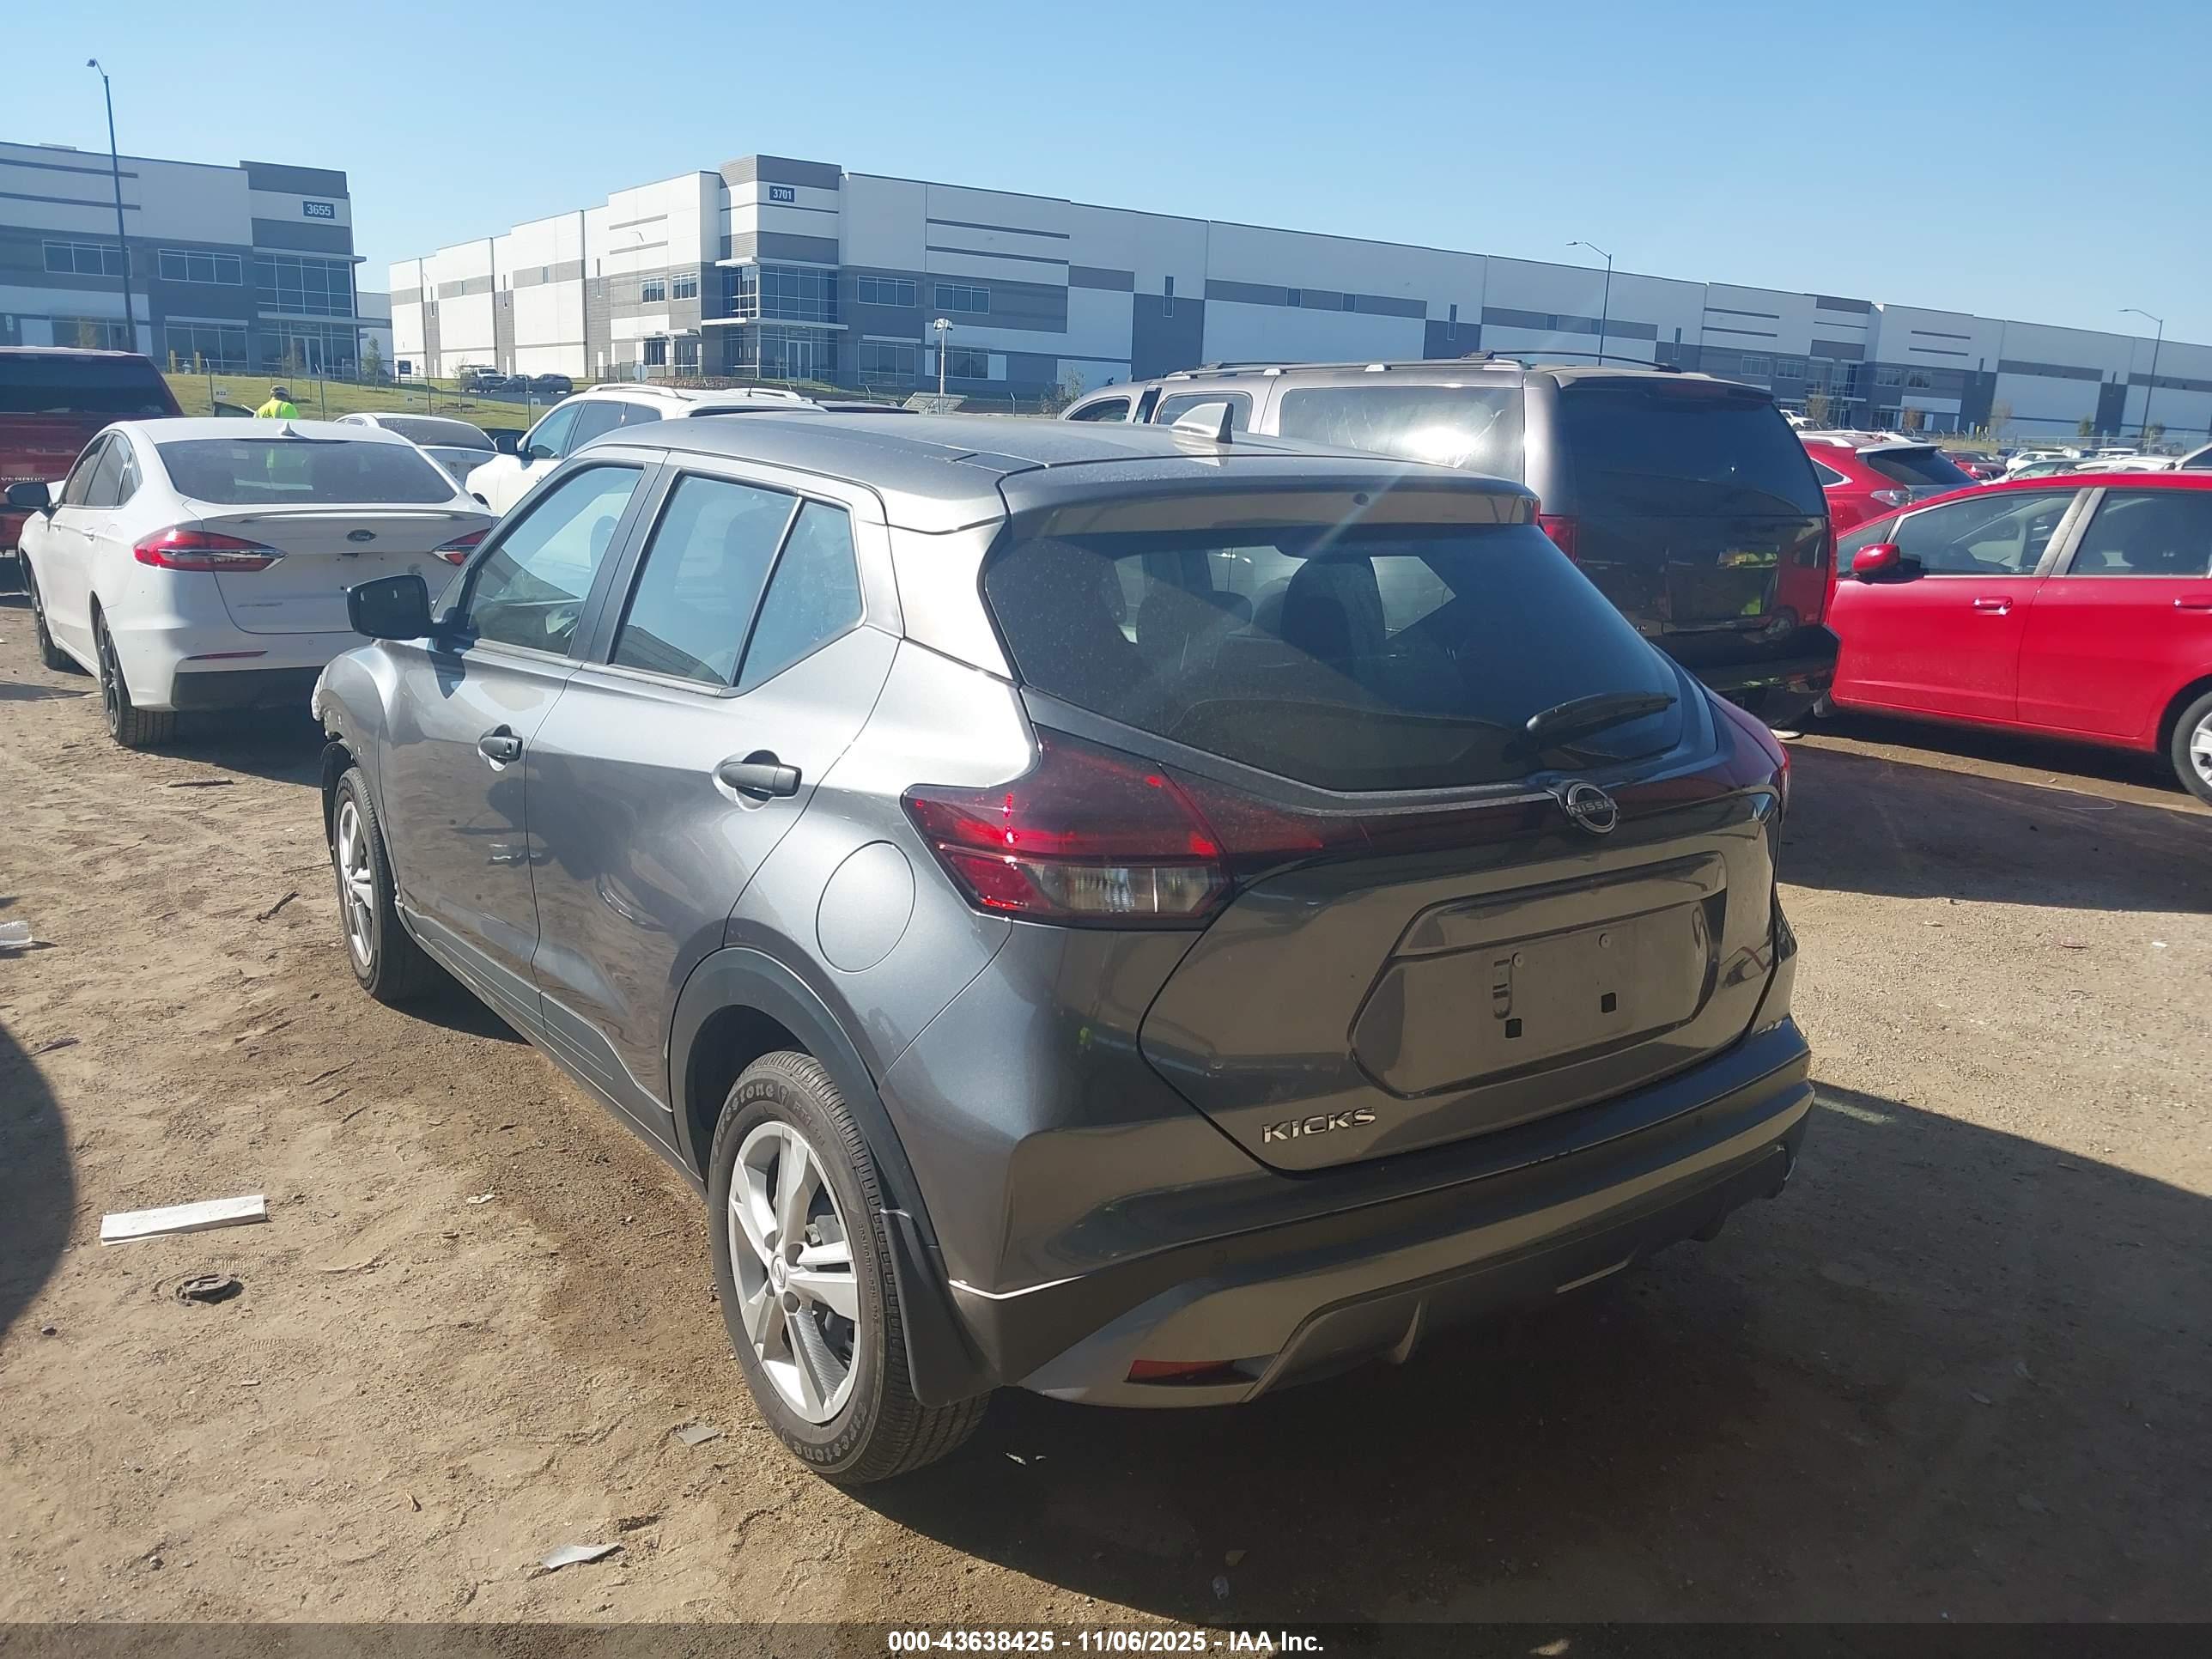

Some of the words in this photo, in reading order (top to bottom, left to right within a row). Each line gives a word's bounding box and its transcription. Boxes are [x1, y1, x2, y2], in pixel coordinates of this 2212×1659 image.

[773, 188, 792, 200] 3701
[307, 204, 331, 216] 3655
[1262, 1107, 1376, 1144] KICKS
